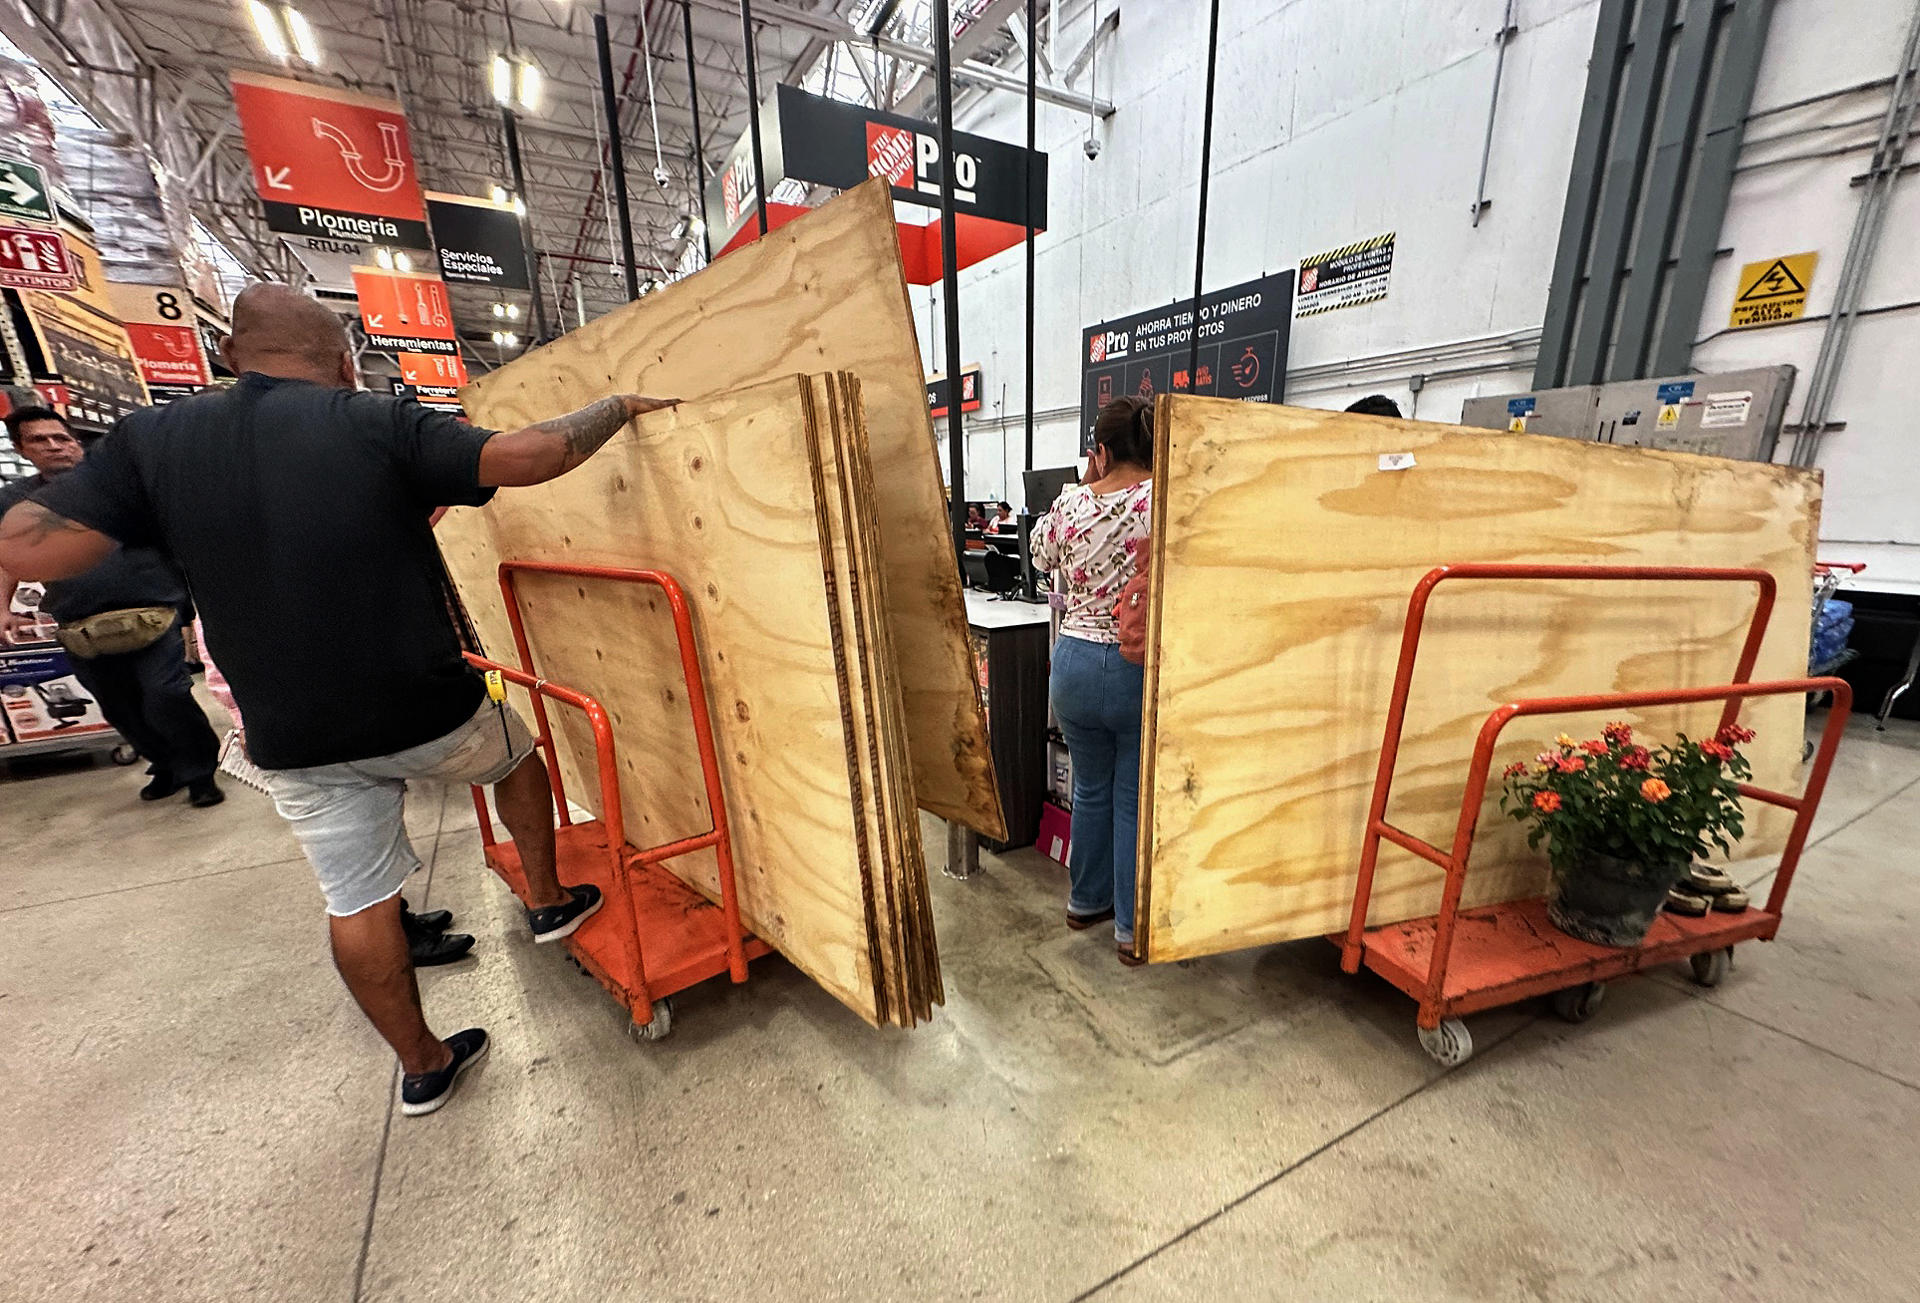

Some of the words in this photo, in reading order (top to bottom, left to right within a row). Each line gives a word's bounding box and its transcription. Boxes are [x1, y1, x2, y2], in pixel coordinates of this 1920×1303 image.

[916, 133, 977, 188] Po
[440, 248, 494, 265] Servicios
[442, 258, 504, 275] Especiales
[156, 291, 183, 321] 8
[1135, 317, 1172, 337] AHORRA
[1211, 304, 1221, 318] Y
[1220, 293, 1262, 315] DINERO
[371, 335, 454, 351] Herramientas
[1106, 331, 1129, 353] Pro
[1135, 339, 1147, 353] EN
[1148, 334, 1166, 349] TUS
[1166, 320, 1225, 346] PROYCTOS
